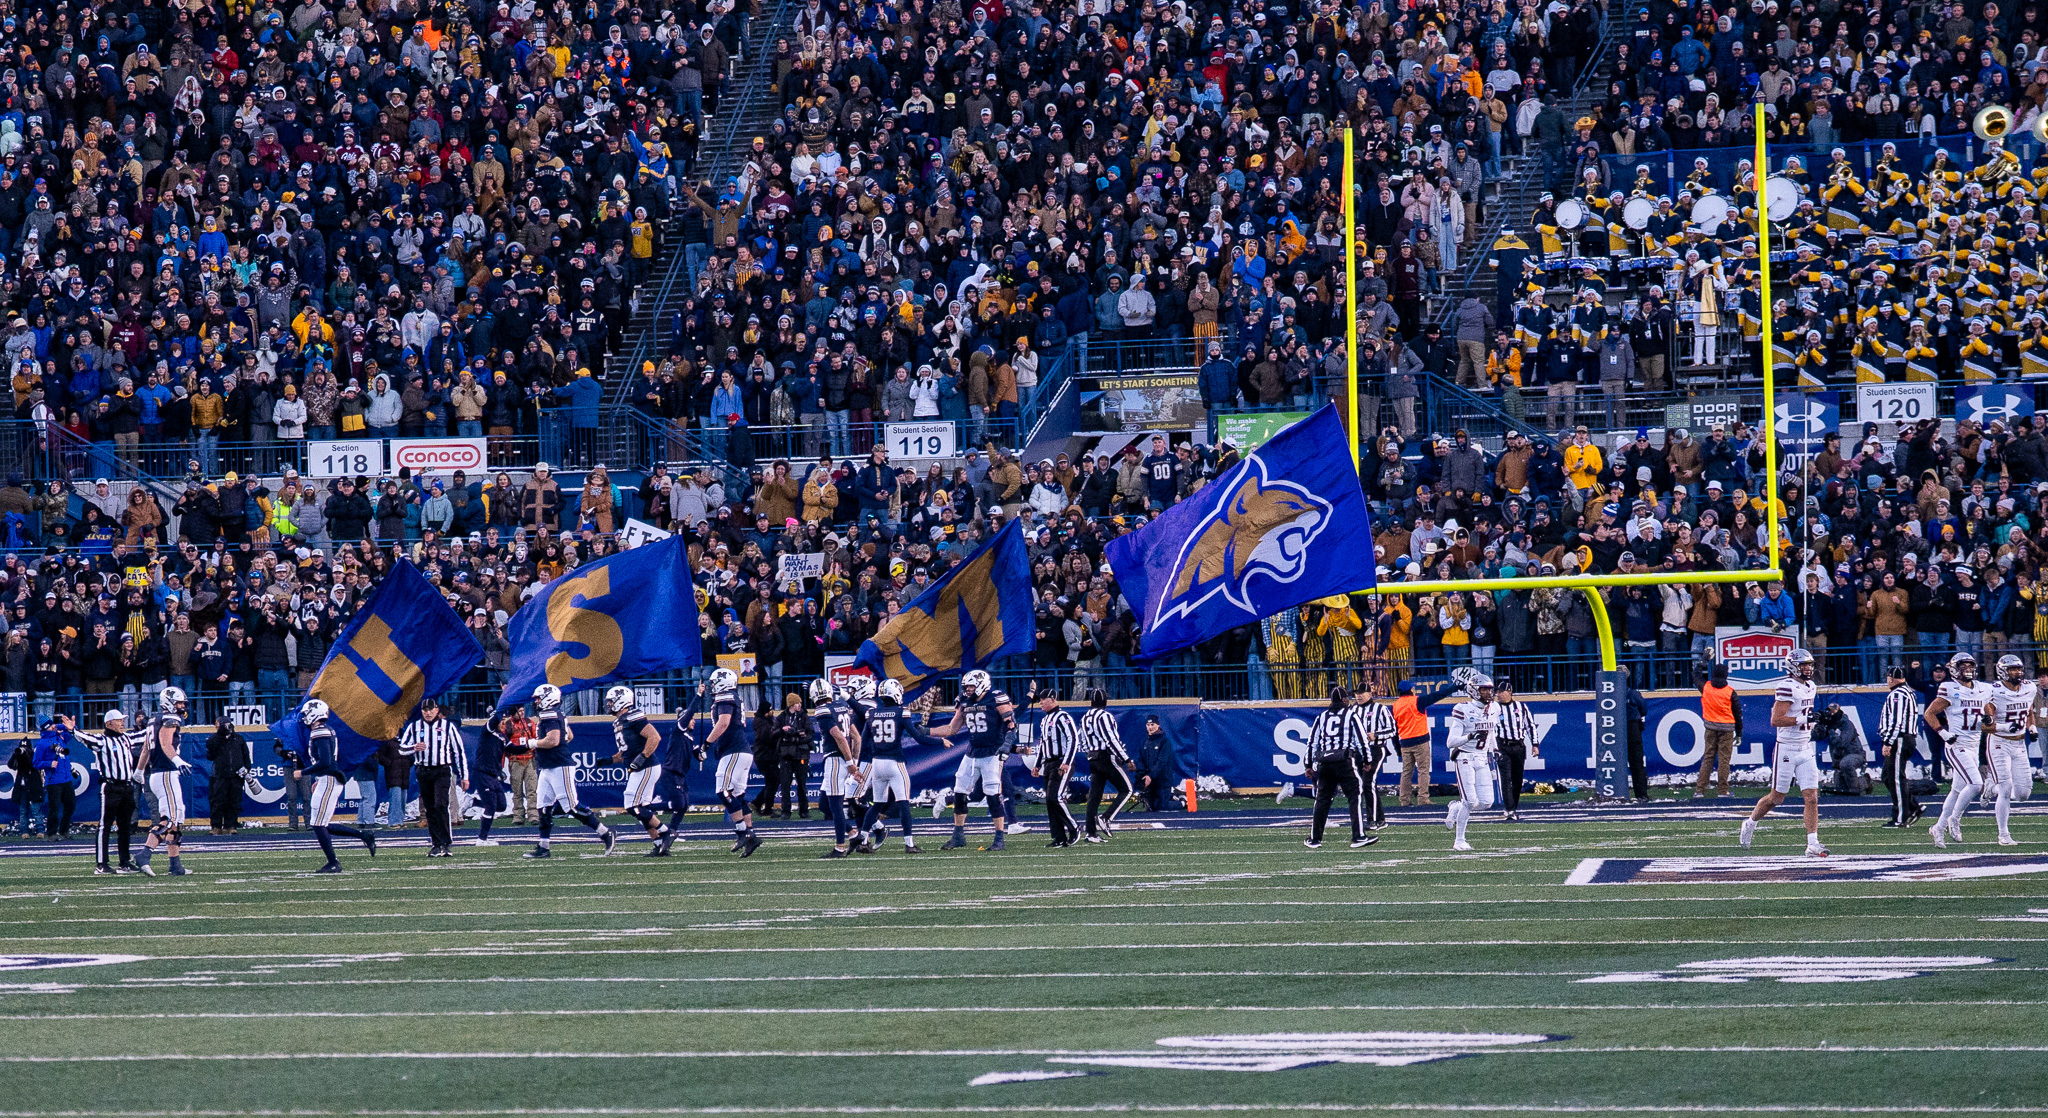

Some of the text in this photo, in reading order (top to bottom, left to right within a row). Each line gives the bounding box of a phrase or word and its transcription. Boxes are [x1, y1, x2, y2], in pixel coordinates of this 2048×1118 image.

[578, 323, 591, 331] 41
[1100, 376, 1199, 389] LET'S START SOMETHIN
[1866, 387, 1927, 396] Student Section
[1693, 403, 1737, 413] DOOR
[1871, 398, 1920, 419] 120
[1694, 415, 1738, 426] TECH
[893, 424, 948, 434] Student Section
[331, 444, 359, 452] Section
[899, 435, 942, 456] 119
[322, 454, 368, 474] 118
[1153, 464, 1170, 480] 00
[792, 564, 819, 572] XMAS
[127, 572, 147, 580] CATS
[546, 565, 624, 686] S
[1725, 643, 1791, 657] town
[1727, 659, 1786, 672] pump
[1960, 700, 1983, 708] MONTANA
[2006, 702, 2029, 710] MONTANA
[226, 708, 261, 725] FTG
[966, 712, 988, 733] 66
[1962, 708, 1983, 731] 17
[872, 719, 896, 743] 39
[1326, 716, 1341, 737] C
[1600, 681, 1617, 797] BOBCATS
[571, 752, 596, 768] SU
[574, 768, 628, 782] OKSTO
